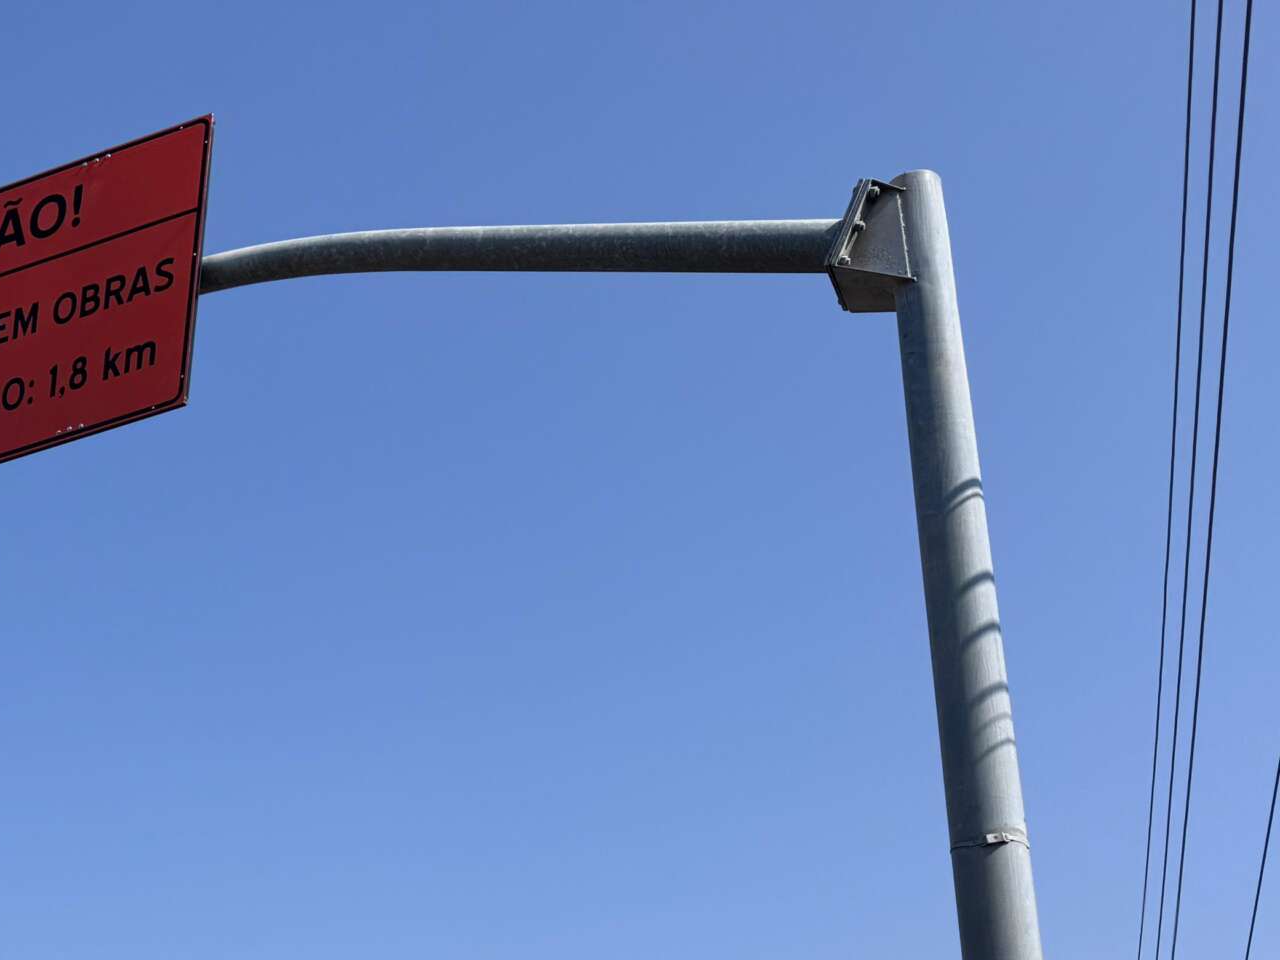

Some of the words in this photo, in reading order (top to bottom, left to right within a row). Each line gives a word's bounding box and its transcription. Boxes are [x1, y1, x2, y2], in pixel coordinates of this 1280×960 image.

[53, 258, 176, 325] OBRAS
[49, 357, 88, 399] 1,8
[101, 340, 158, 382] km
